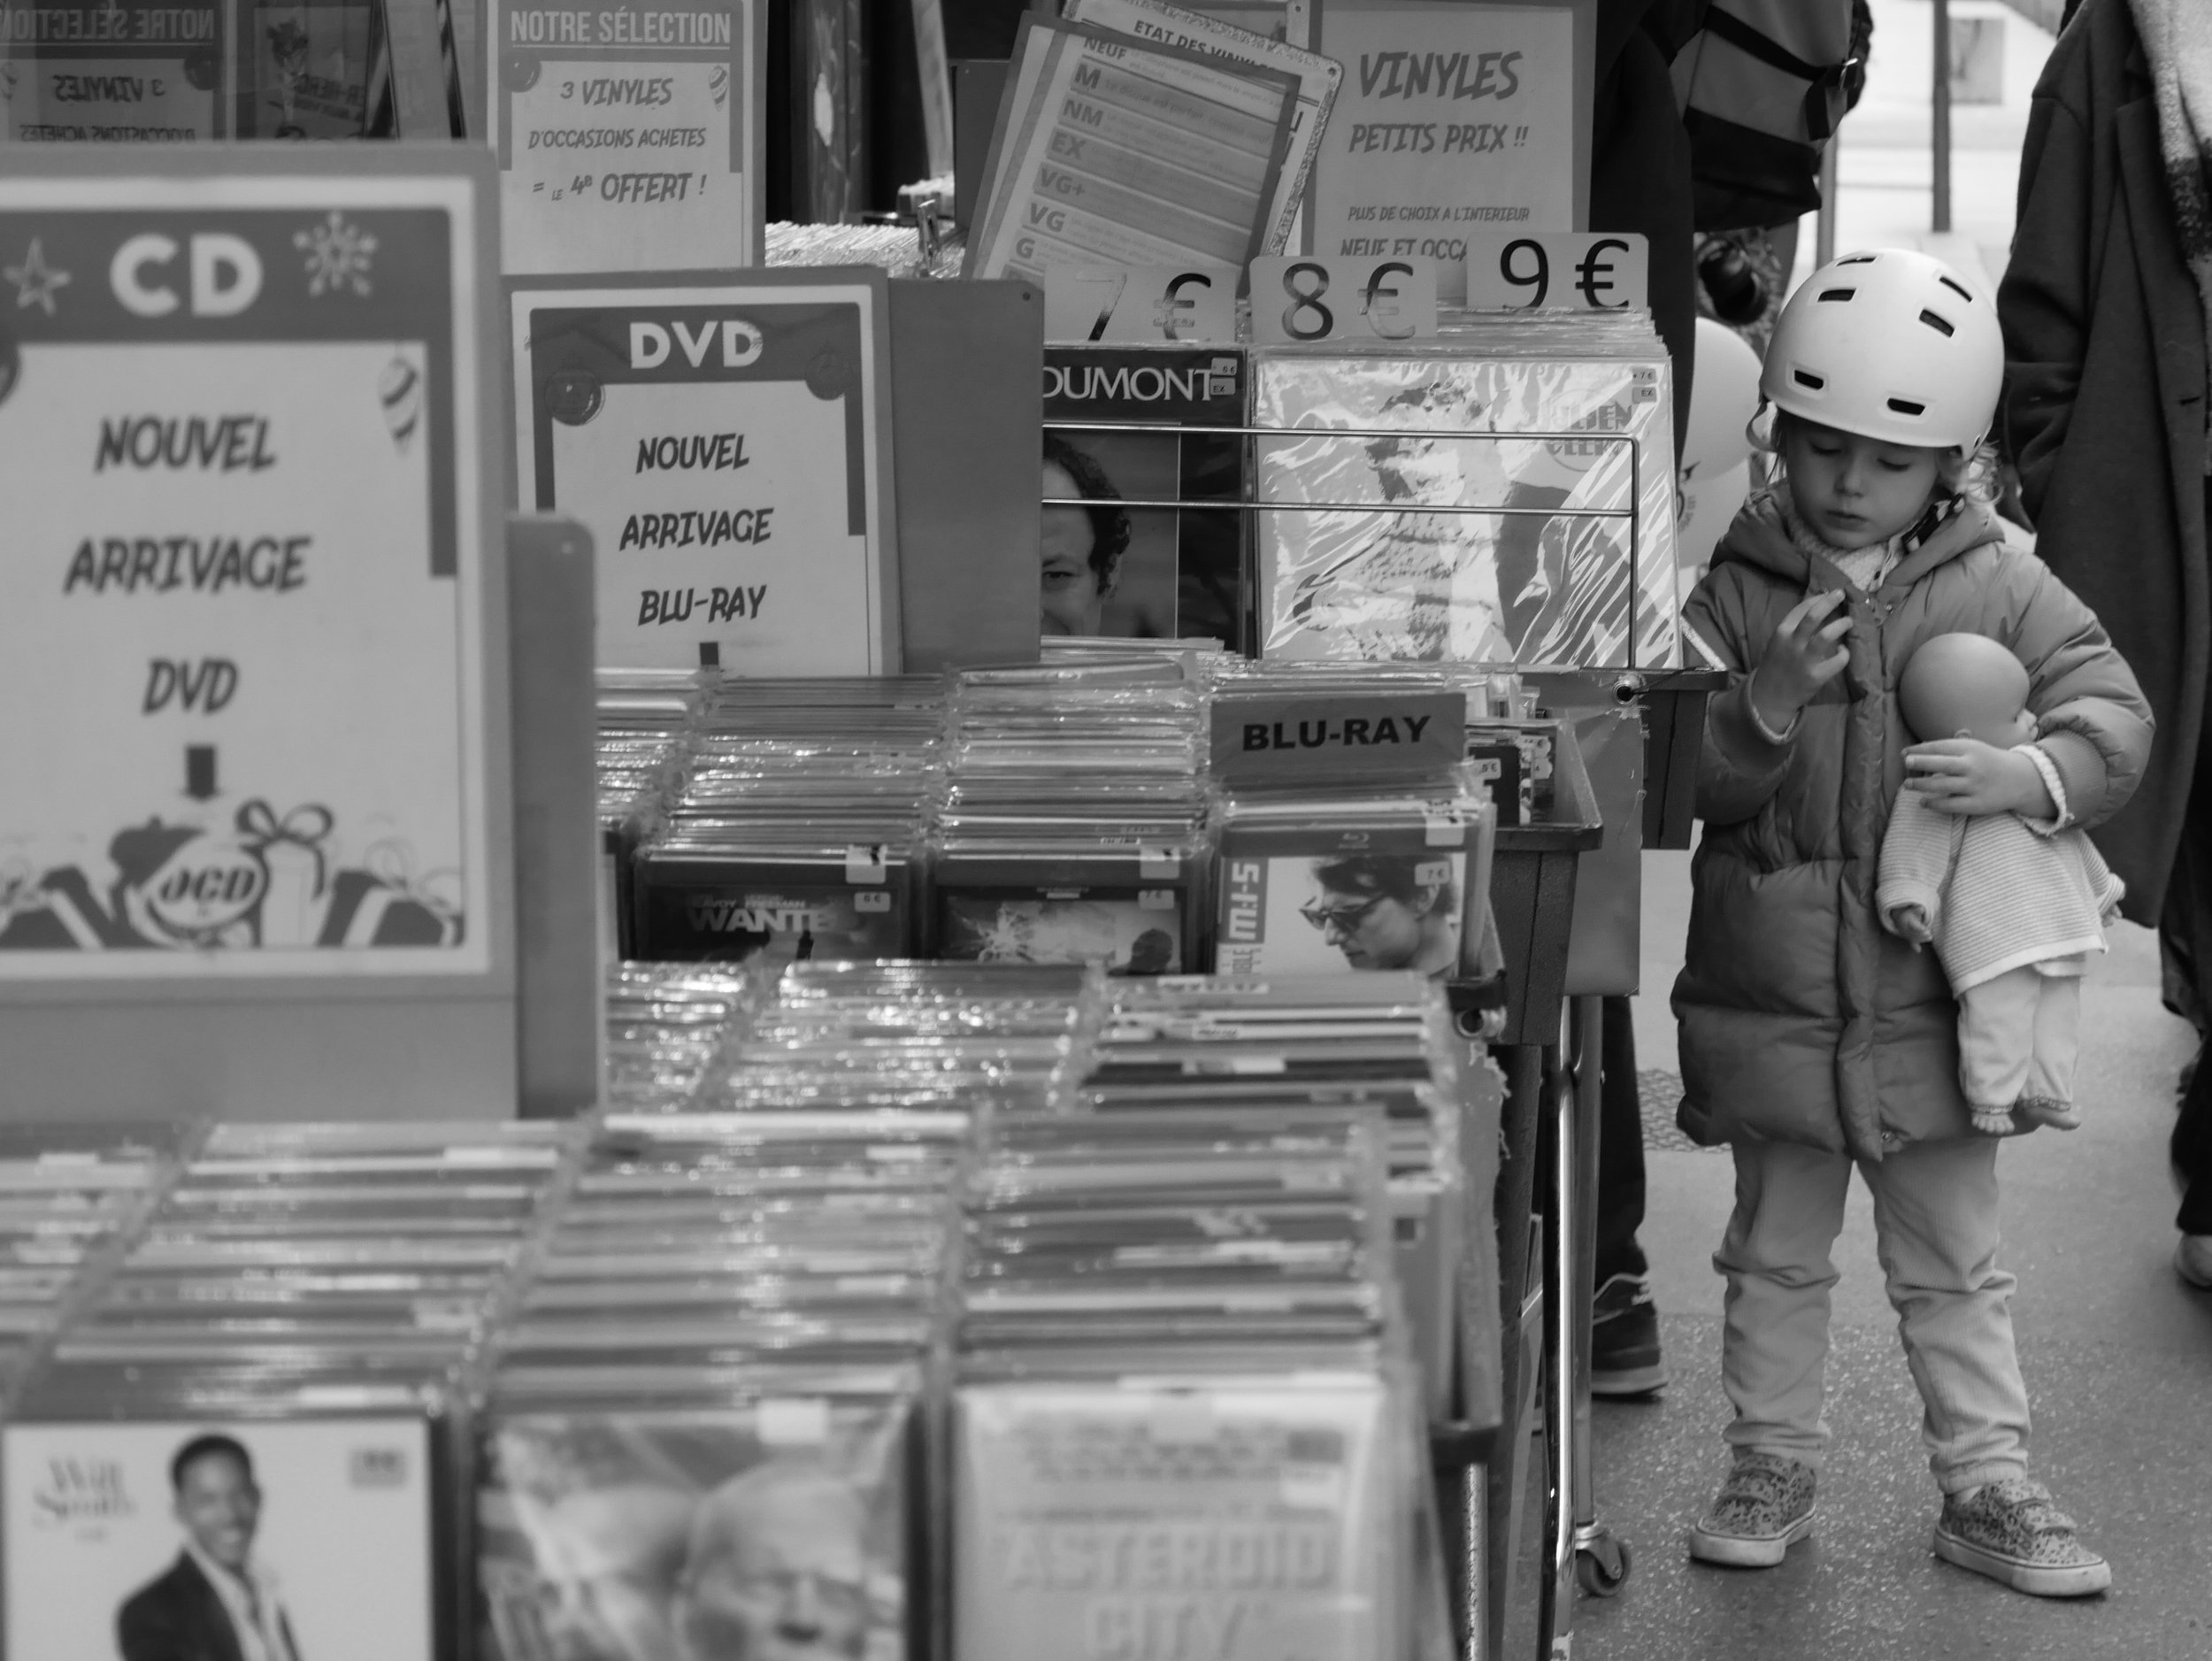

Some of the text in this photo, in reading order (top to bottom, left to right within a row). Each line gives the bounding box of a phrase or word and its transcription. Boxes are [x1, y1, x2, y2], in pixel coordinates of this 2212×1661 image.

[511, 5, 730, 44] NOTRE SÉLECTION
[1133, 19, 1174, 44] ETAT
[1177, 35, 1207, 56] DES
[1084, 36, 1126, 60] NEUF
[560, 78, 673, 105] 3 VINYLES
[1073, 63, 1102, 89] M
[1360, 50, 1524, 101] VINYLES
[1063, 99, 1103, 127] NM
[528, 127, 706, 150] D'OCCASIONS ACHETES
[1050, 133, 1087, 160] EX
[1348, 123, 1437, 154] PETITS
[1442, 124, 1508, 154] PRIX
[552, 188, 564, 201] LE
[601, 173, 693, 203] OFFERT
[1041, 168, 1085, 196] VG+
[1029, 202, 1065, 233] VG
[1348, 206, 1530, 221] PLUS DE CHOIX A L'INTERIEUR
[1016, 237, 1036, 260] G
[1340, 238, 1388, 257] NEUF
[1393, 238, 1416, 257] ET
[109, 232, 264, 318] CD
[1500, 238, 1632, 308] 9 €
[1075, 271, 1212, 342] 7 €
[1280, 262, 1417, 341] 8 €
[629, 319, 764, 370] DVD
[95, 413, 278, 474] NOUVEL
[635, 433, 750, 474] NOUVEL
[618, 507, 774, 552] ARRIVAGE
[63, 534, 313, 596] ARRIVAGE
[637, 584, 768, 627] BLU-RAY
[142, 656, 240, 717] DVD
[1242, 715, 1432, 752] BLU-RAY
